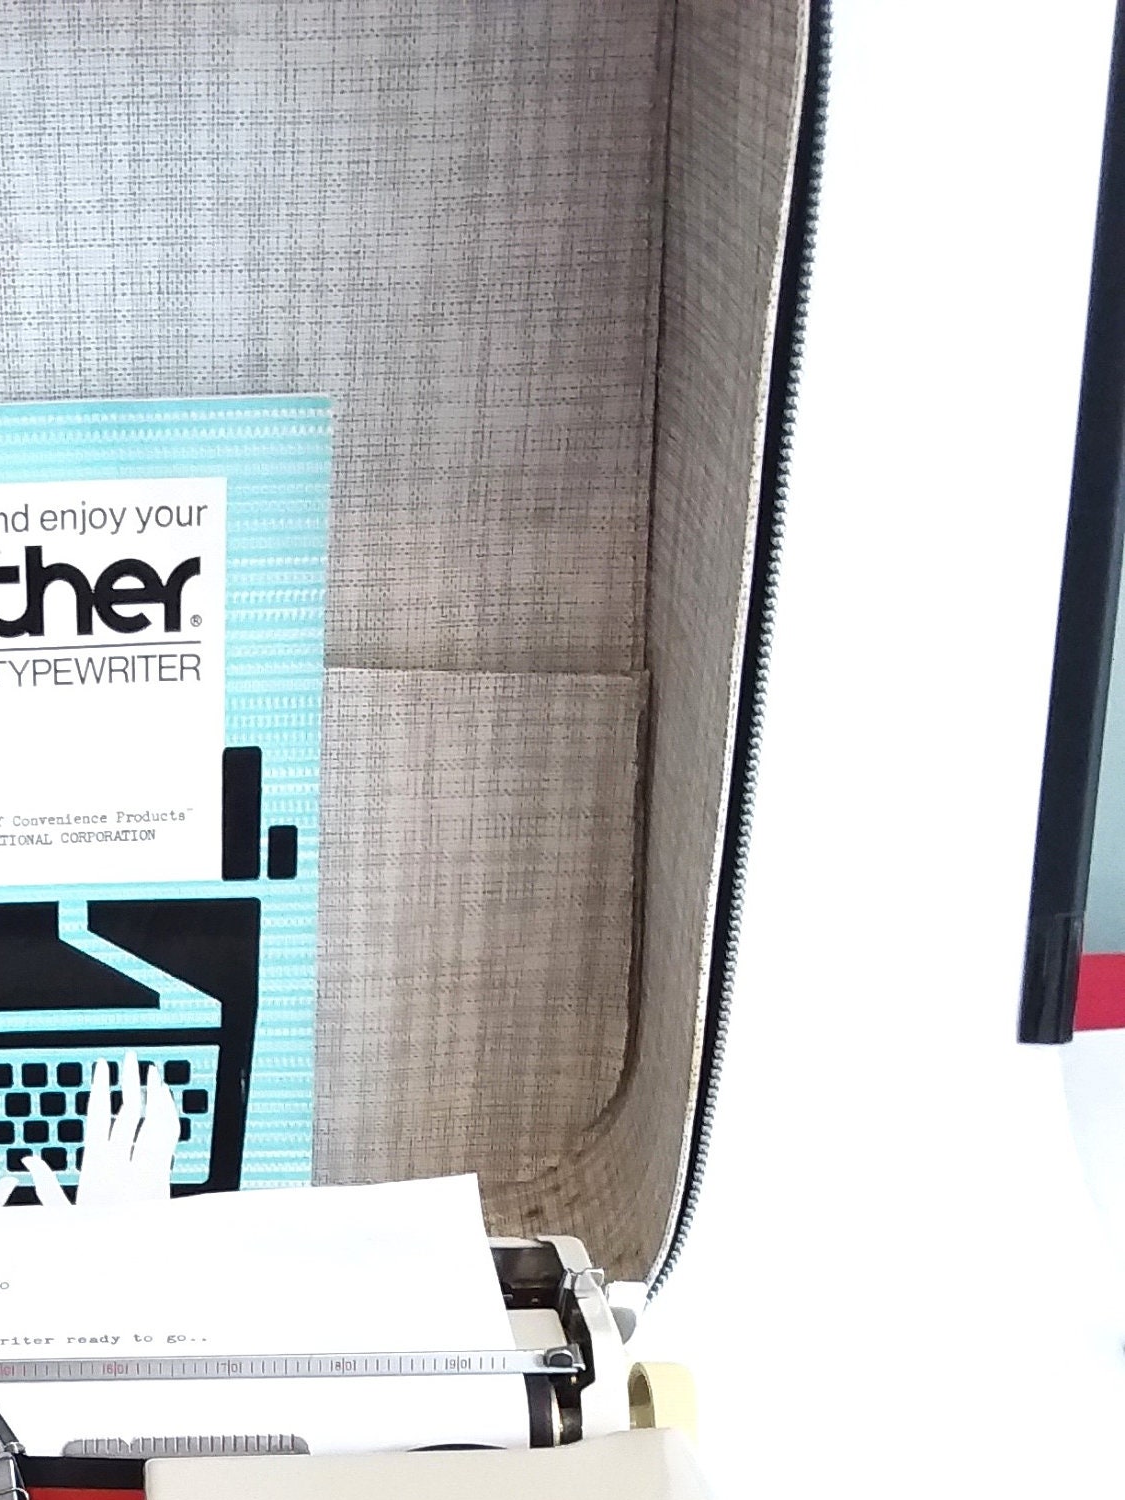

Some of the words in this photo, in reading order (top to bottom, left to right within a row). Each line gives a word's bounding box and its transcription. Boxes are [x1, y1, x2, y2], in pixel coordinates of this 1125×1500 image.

[40, 501, 126, 535] enjoy
[135, 505, 208, 534] your
[13, 812, 108, 827] Convenience
[61, 829, 156, 843] CORPORATION
[67, 1334, 121, 1345] ready
[134, 1333, 153, 1343] to
